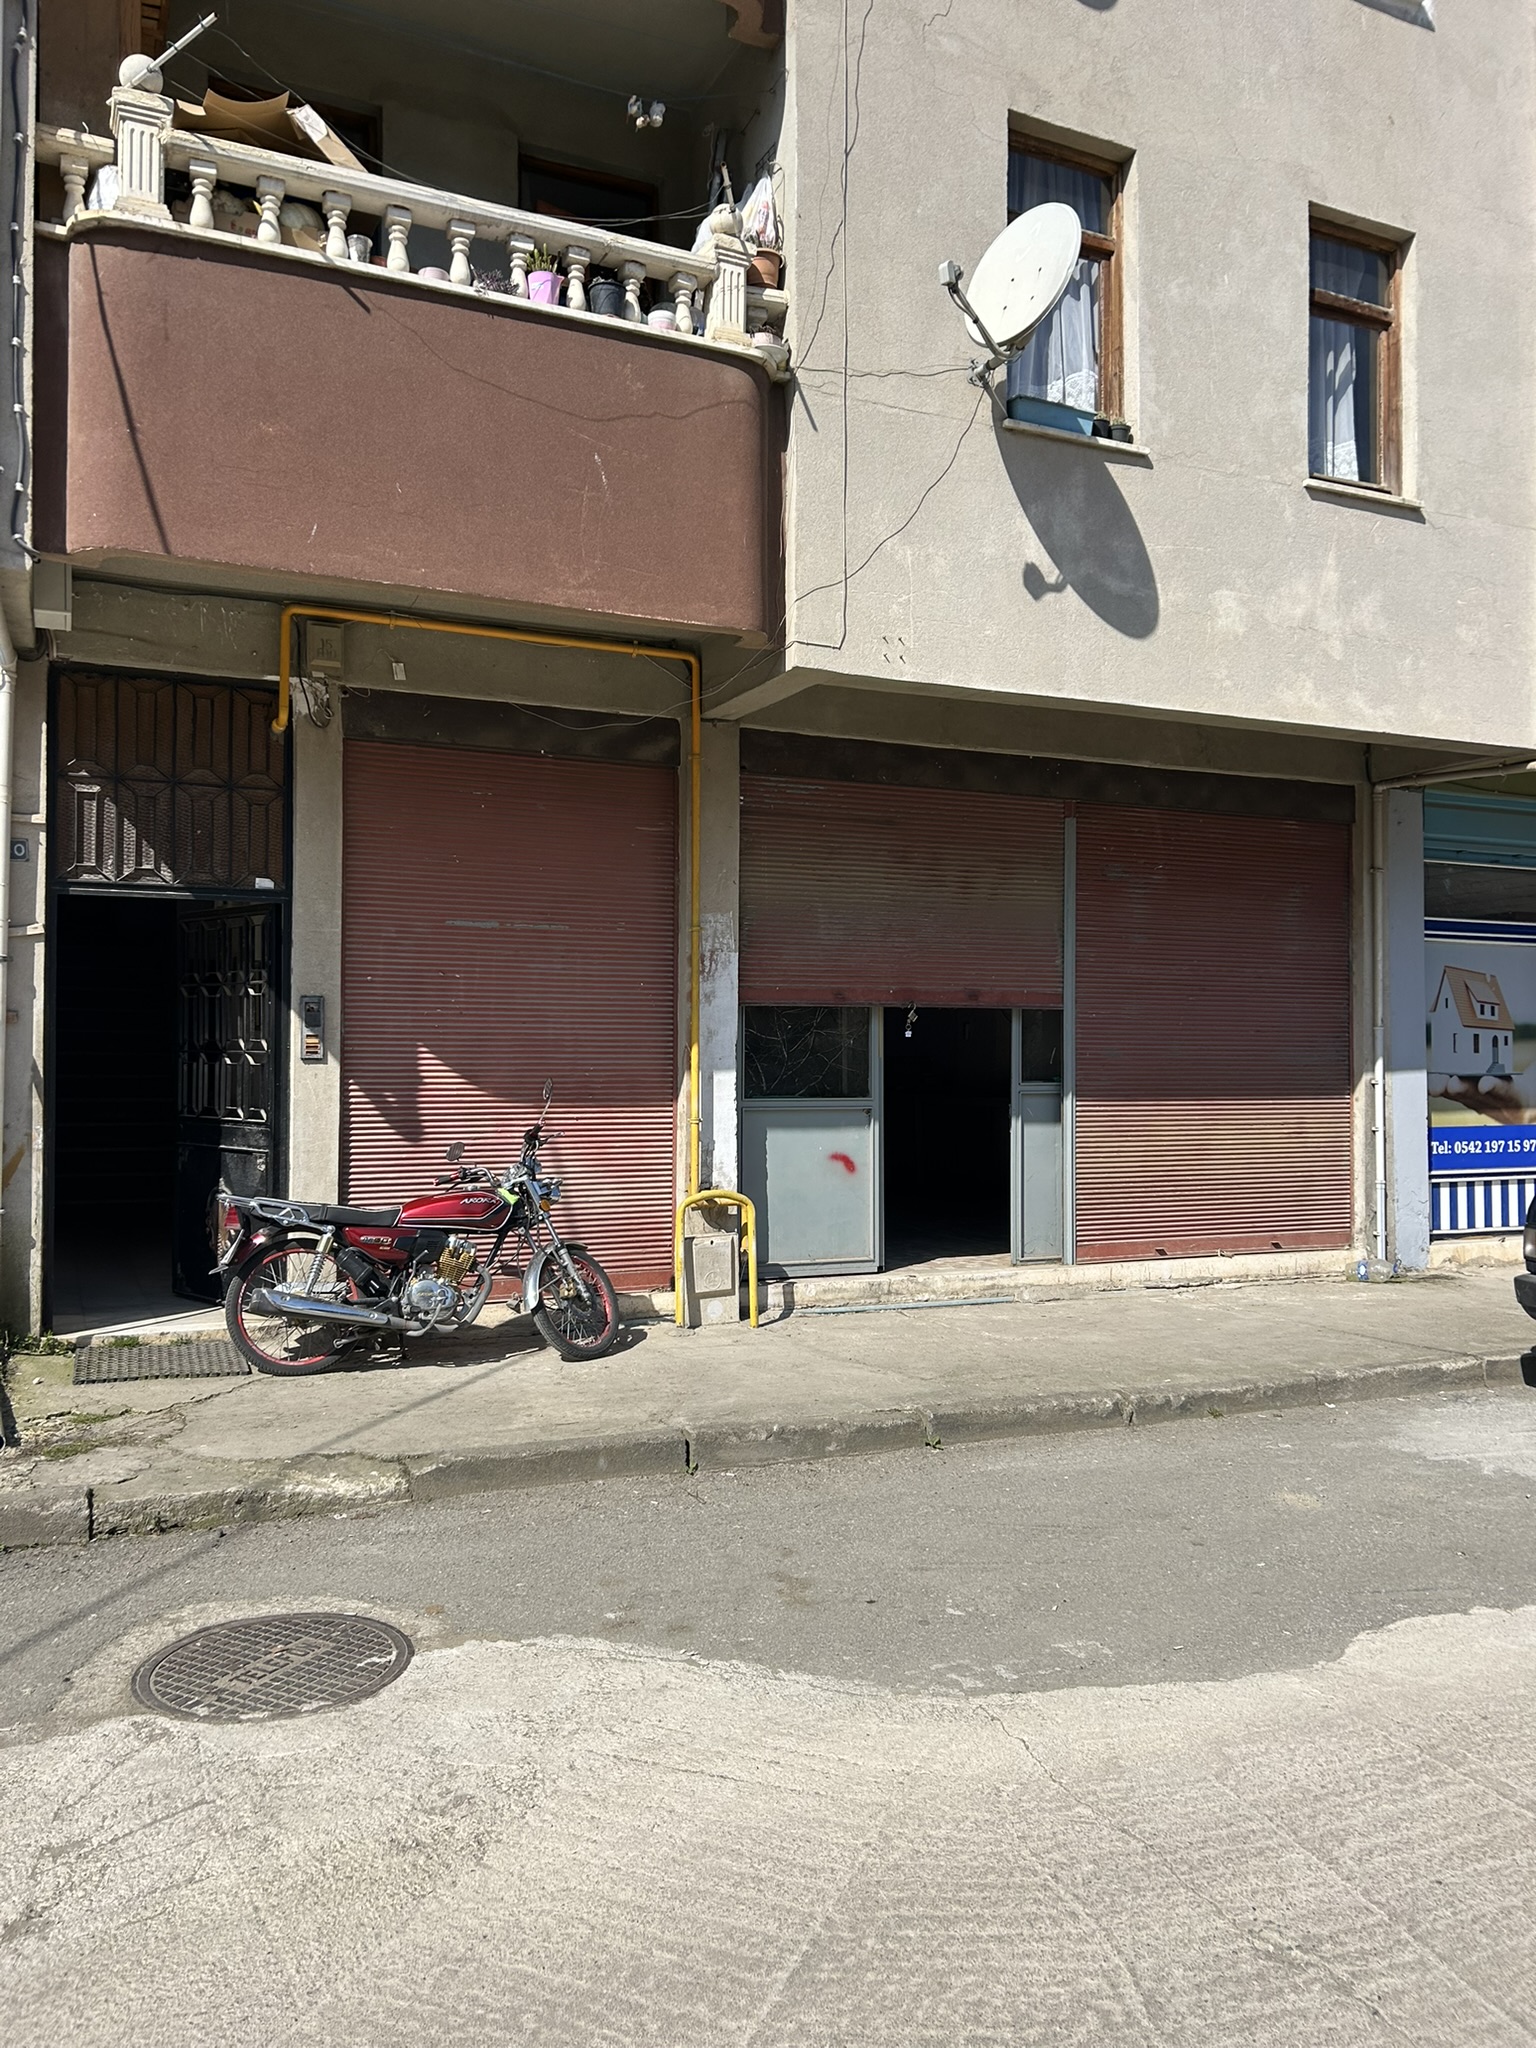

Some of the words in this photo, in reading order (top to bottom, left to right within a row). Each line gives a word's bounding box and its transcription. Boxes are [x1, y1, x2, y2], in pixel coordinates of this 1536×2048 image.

[1431, 1140, 1452, 1154] Tel:
[1454, 1140, 1482, 1154] 0542
[1484, 1139, 1506, 1153] 197
[1507, 1139, 1521, 1153] 15
[1522, 1138, 1536, 1152] 97
[227, 1641, 323, 1685] TELEFON
